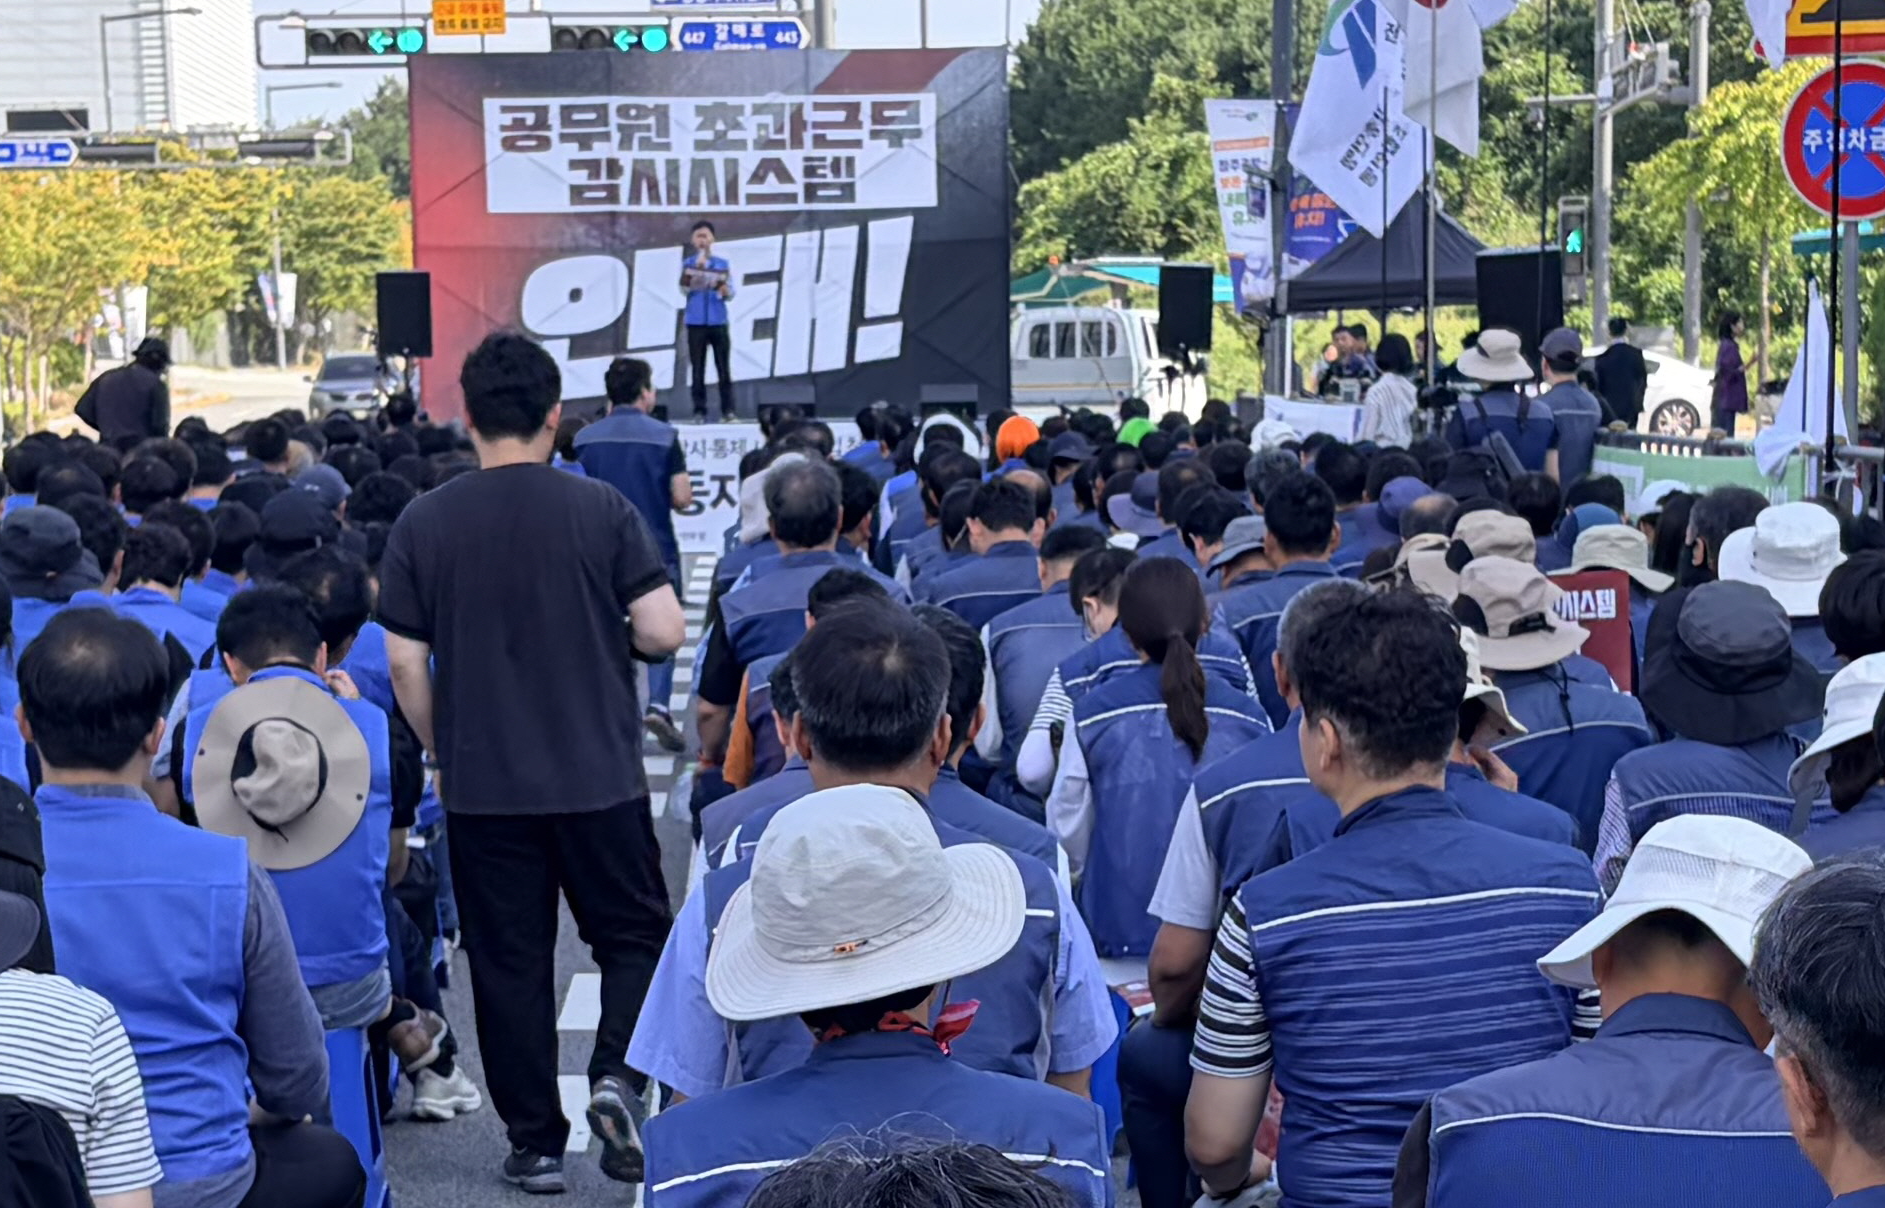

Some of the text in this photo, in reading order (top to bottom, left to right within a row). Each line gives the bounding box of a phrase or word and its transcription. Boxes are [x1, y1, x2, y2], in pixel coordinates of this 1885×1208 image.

[498, 99, 923, 153] 공무원 초과근무
[567, 155, 857, 207] 감시시스템
